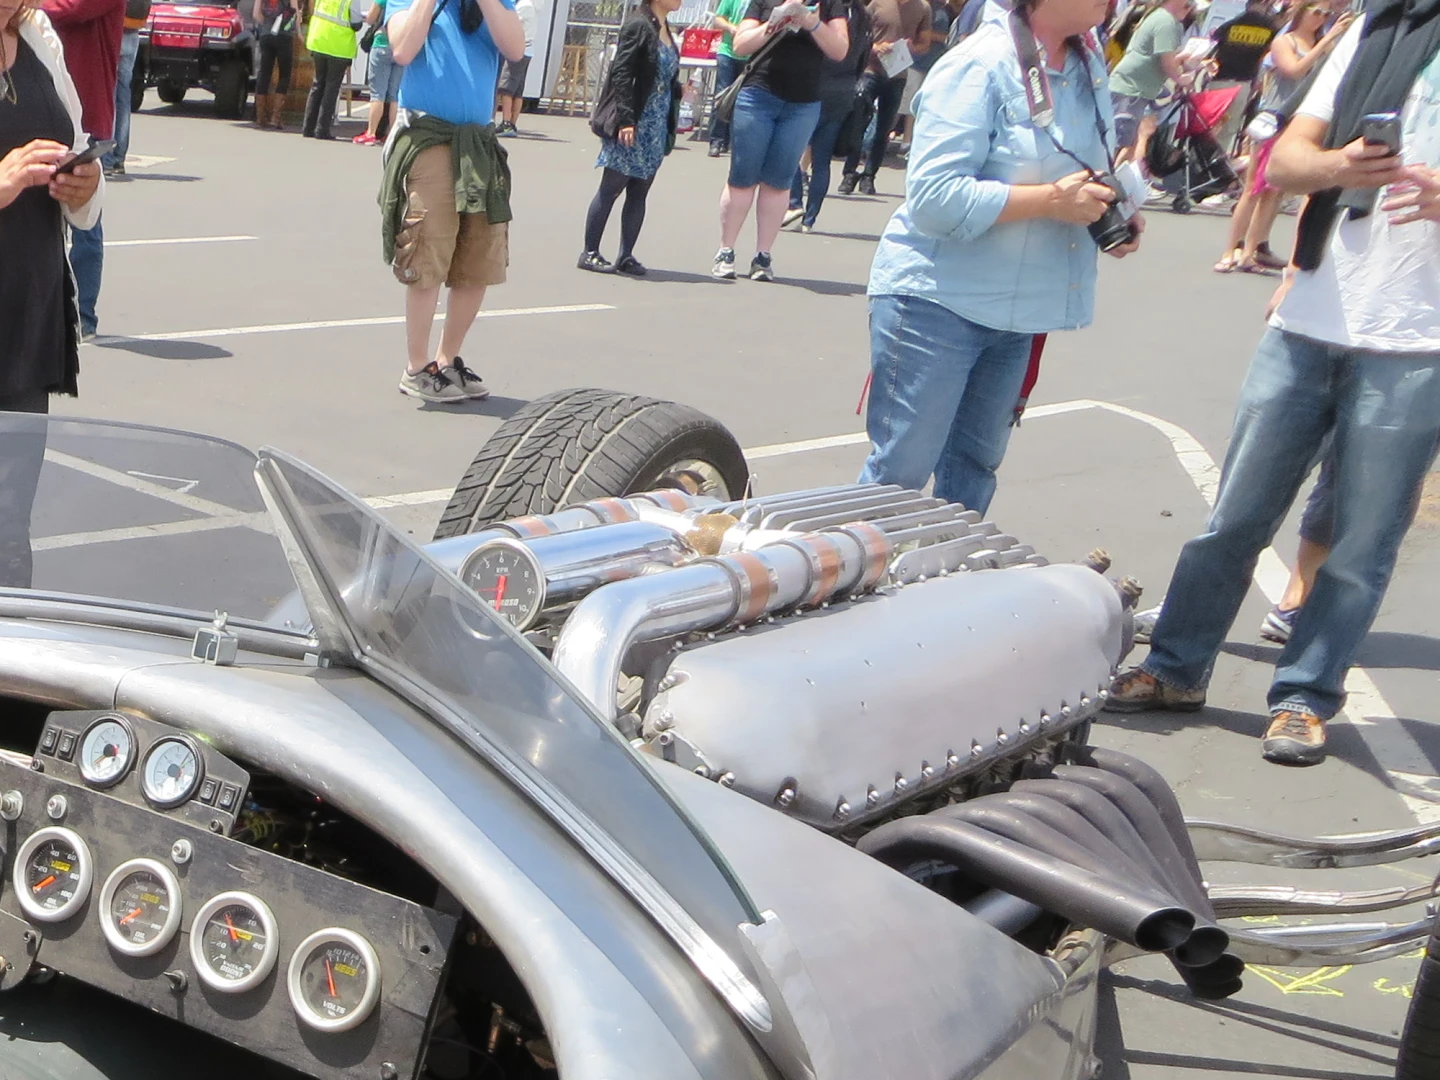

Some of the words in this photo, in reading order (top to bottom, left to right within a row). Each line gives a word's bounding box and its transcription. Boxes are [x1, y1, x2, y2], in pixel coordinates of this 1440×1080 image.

[1028, 66, 1044, 104] Canon
[519, 604, 527, 612] 10
[60, 890, 73, 898] 100
[247, 919, 257, 927] 10
[220, 928, 229, 936] 10
[216, 940, 227, 949] 20
[252, 942, 264, 950] 20
[219, 964, 244, 978] BOOST
[334, 963, 358, 977] JEGS
[323, 1000, 346, 1014] VOLTS
